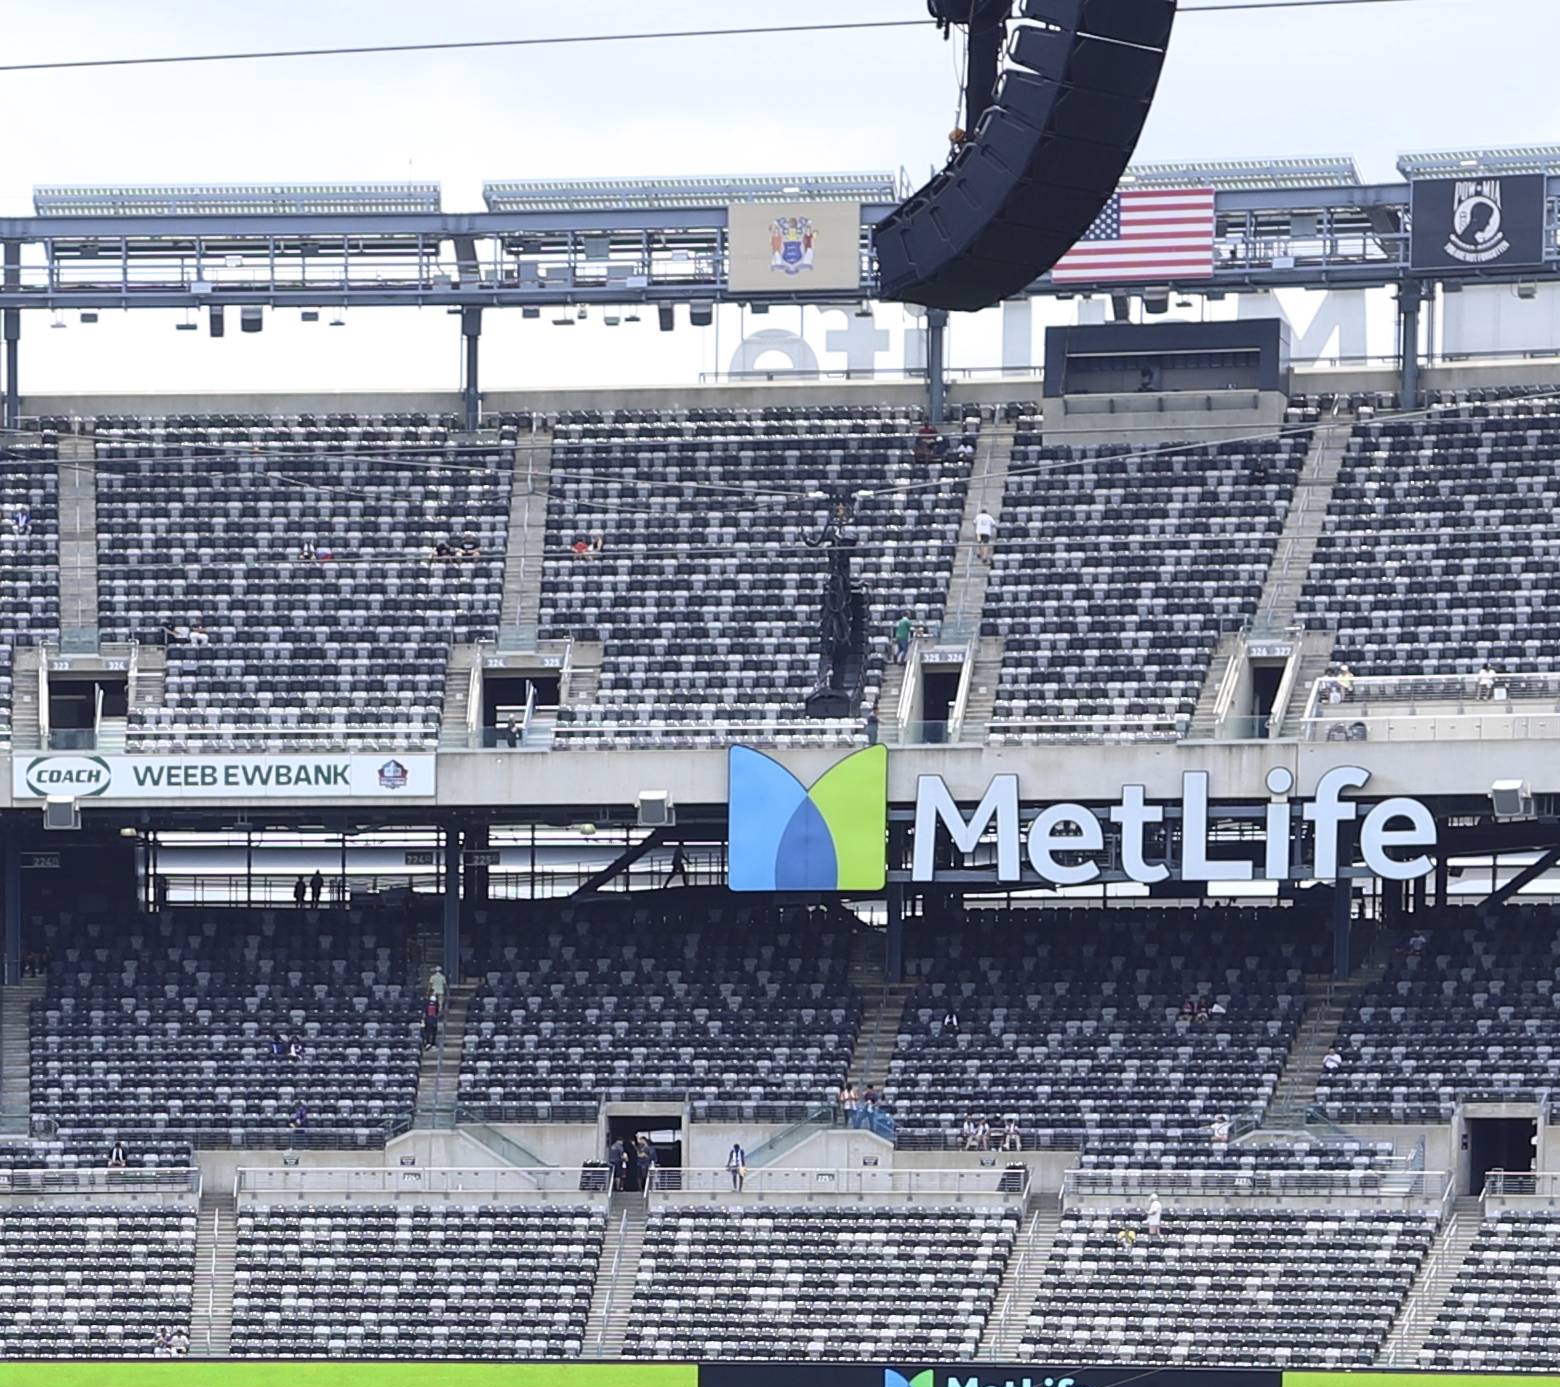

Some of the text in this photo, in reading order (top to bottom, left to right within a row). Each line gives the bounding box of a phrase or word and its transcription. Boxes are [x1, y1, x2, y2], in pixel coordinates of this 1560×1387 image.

[1251, 647, 1267, 656] 326
[1275, 646, 1291, 655] 327
[543, 657, 560, 667] 325
[923, 653, 940, 662] 325
[946, 653, 963, 662] 326
[53, 661, 69, 670] 323
[108, 660, 125, 669] 324
[487, 658, 504, 667] 324
[36, 763, 350, 787] COACH WEEB EWBANK
[911, 765, 1438, 884] MetLife
